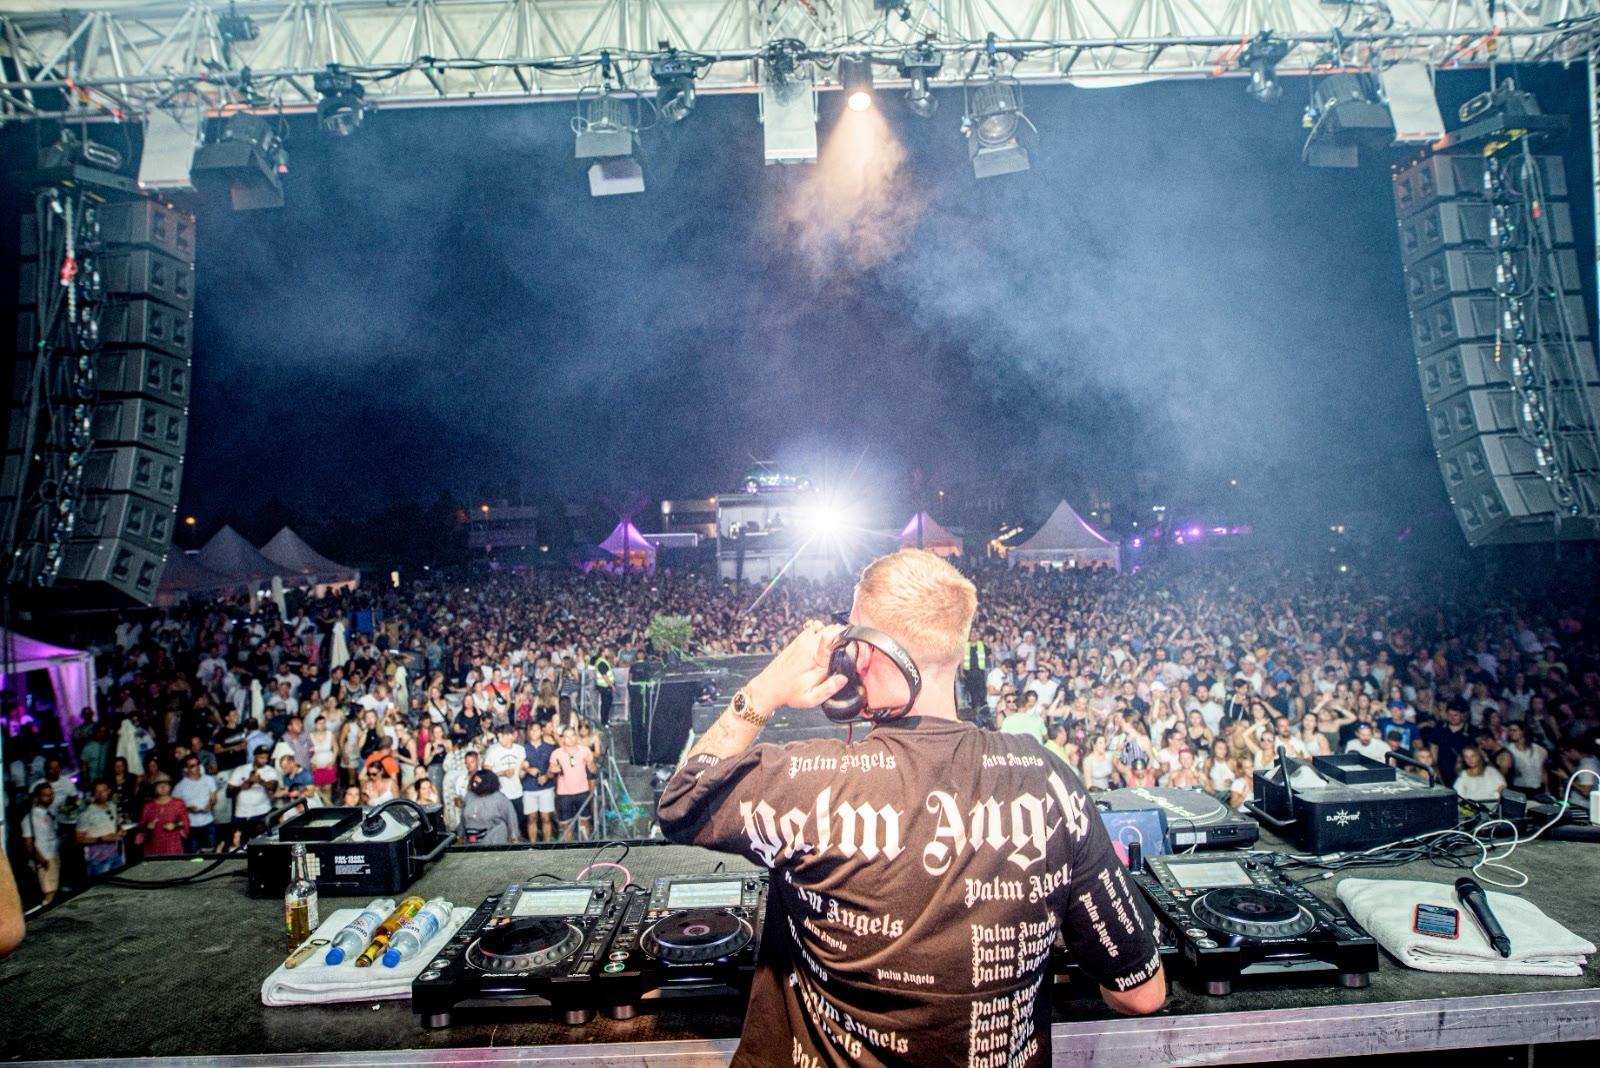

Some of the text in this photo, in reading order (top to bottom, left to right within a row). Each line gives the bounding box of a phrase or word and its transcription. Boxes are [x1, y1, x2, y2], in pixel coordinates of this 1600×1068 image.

[788, 751, 896, 779] Palm Angels
[740, 786, 905, 869] Palm
[965, 875, 1025, 908] Palm
[1098, 868, 1116, 900] Palm
[827, 899, 904, 938] Angels
[1079, 891, 1119, 958] Palm Angels
[971, 924, 1015, 946] Palm
[971, 944, 1015, 966] Palm
[877, 969, 935, 985] Palm Angels
[971, 964, 1015, 988] Palm
[1115, 970, 1146, 992] Palm
[970, 996, 1009, 1019] Palm
[843, 1012, 909, 1054] Angels
[969, 1014, 1009, 1038] Palm
[969, 1032, 1008, 1055] Palm
